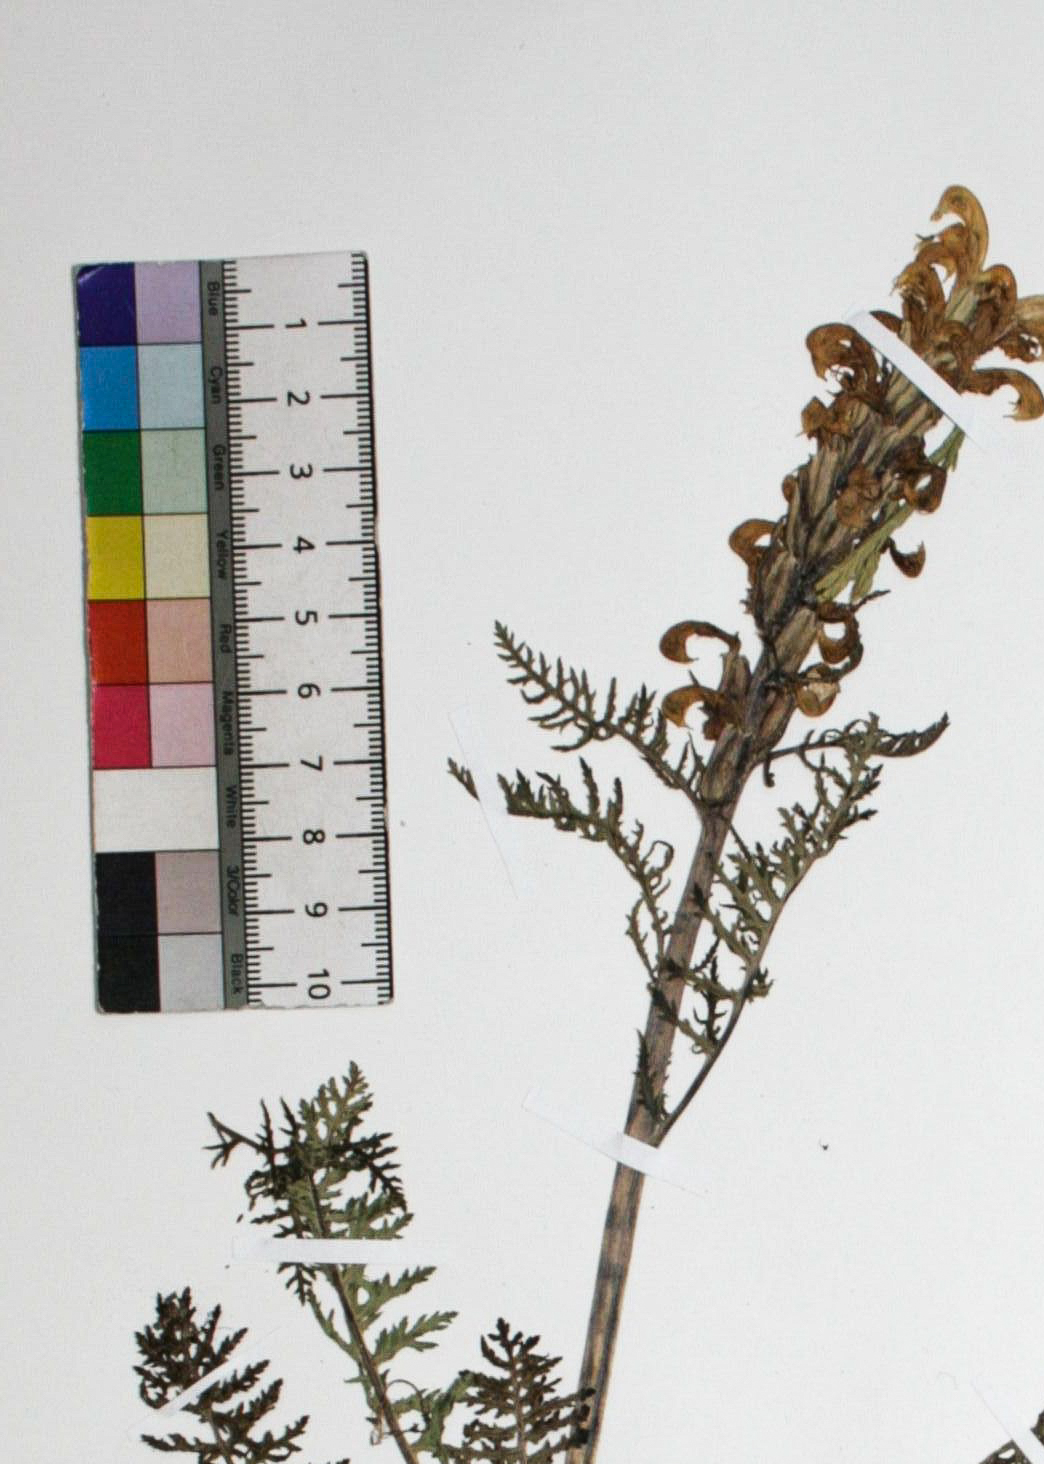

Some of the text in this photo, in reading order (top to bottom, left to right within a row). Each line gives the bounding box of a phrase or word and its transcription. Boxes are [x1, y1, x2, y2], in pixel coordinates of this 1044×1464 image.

[207, 281, 220, 316] Blue
[285, 318, 307, 328] 1
[210, 366, 223, 404] Cyan
[287, 391, 311, 407] 2
[212, 445, 226, 490] Green
[290, 464, 313, 480] 3
[217, 529, 229, 580] Yellow
[293, 536, 316, 554] 4
[295, 610, 319, 625] 5
[220, 623, 232, 653] Red
[298, 683, 321, 699] 6
[220, 691, 233, 755] Magenta
[300, 755, 324, 772] 7
[226, 785, 238, 829] White
[302, 829, 326, 845] 8
[227, 864, 240, 916] 3/Color
[305, 902, 329, 918] 9
[231, 953, 243, 994] Black
[307, 969, 332, 1000] 10
